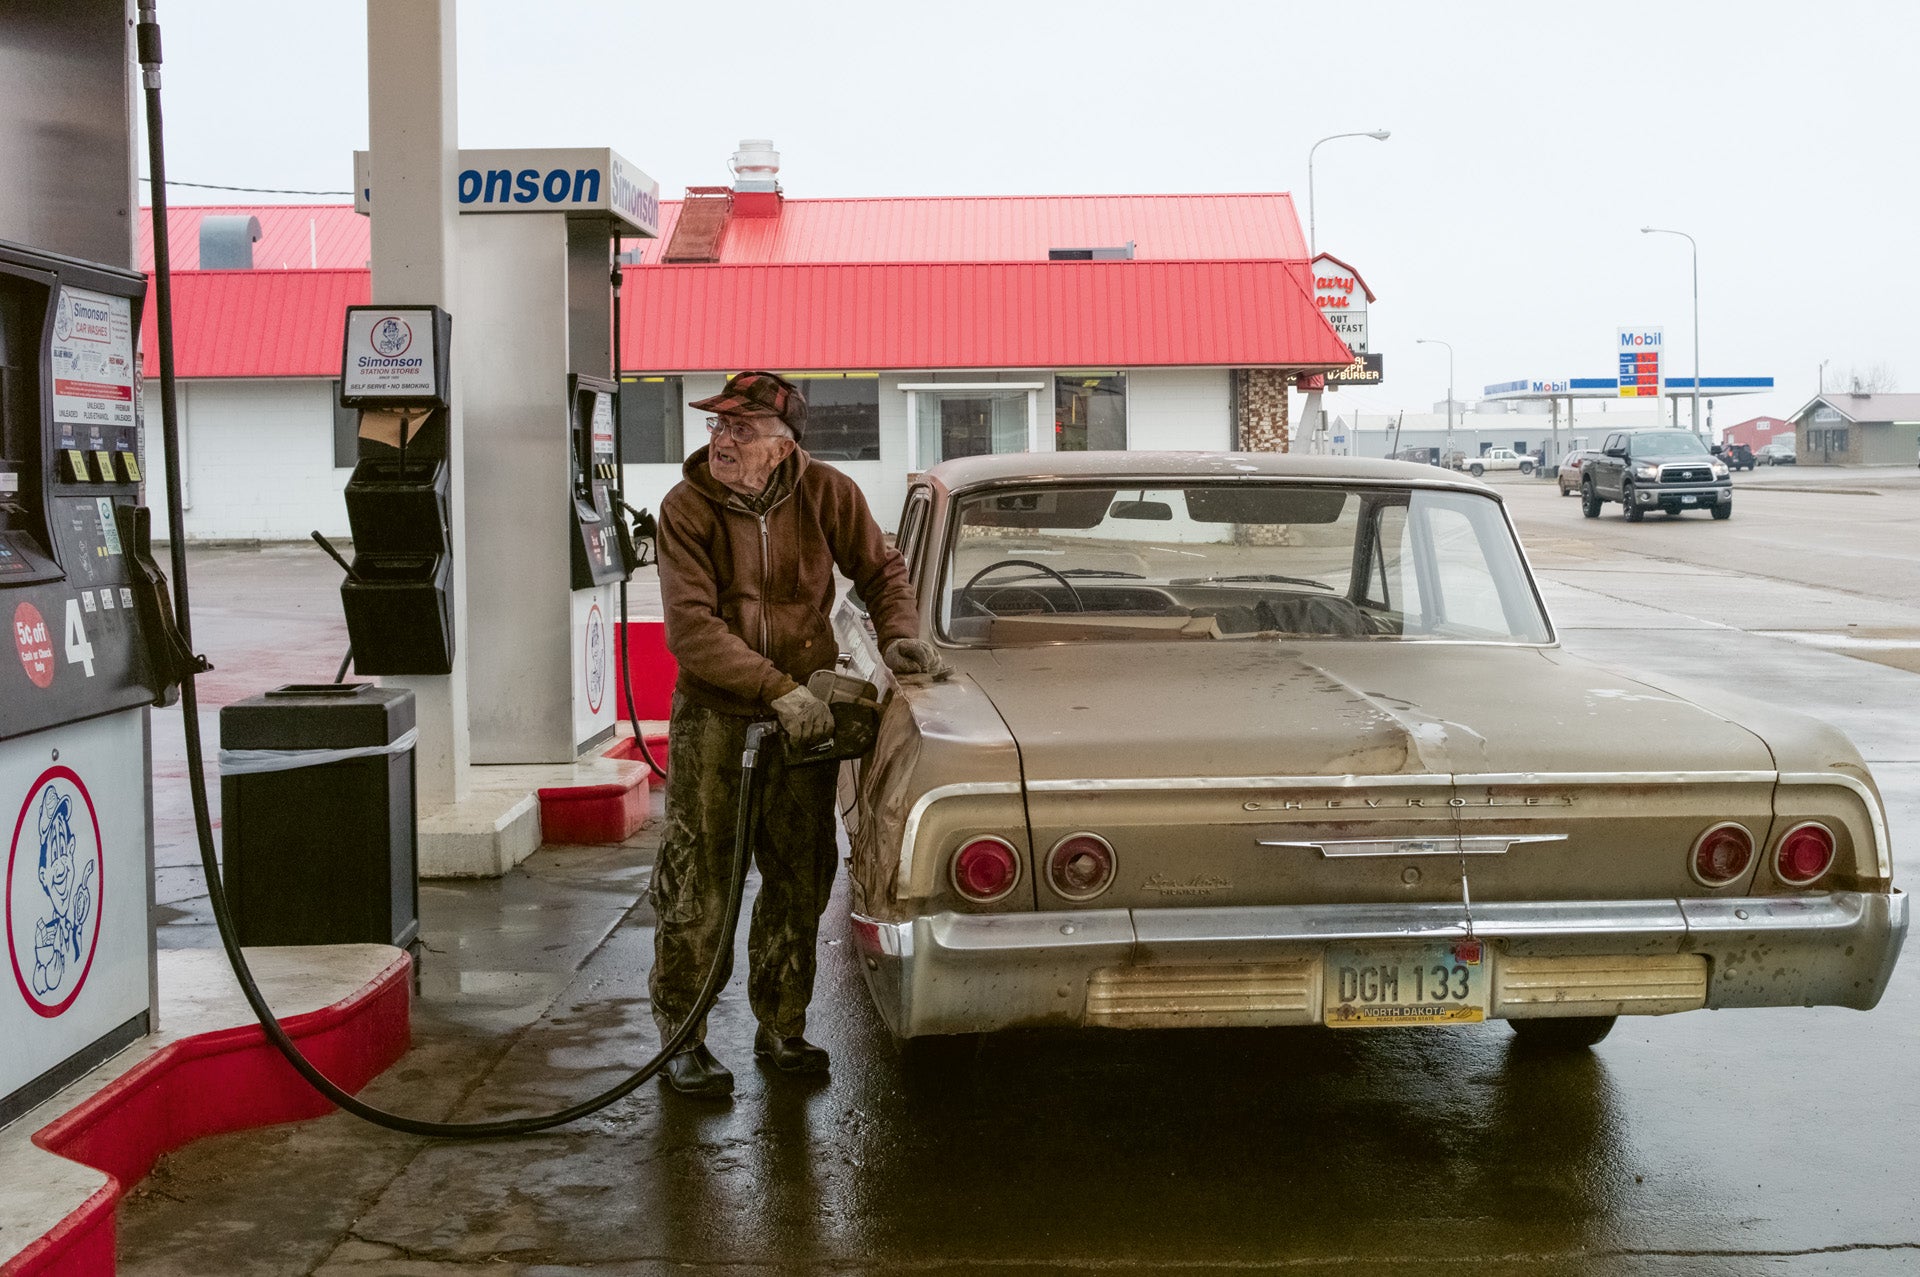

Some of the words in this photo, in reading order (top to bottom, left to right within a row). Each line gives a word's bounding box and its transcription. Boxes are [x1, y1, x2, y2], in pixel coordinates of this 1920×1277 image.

[612, 160, 659, 230] Simonson
[1311, 272, 1354, 294] airy
[1316, 295, 1350, 308] arn
[73, 302, 109, 322] Simonson
[1330, 315, 1348, 323] OUT
[76, 322, 87, 334] CAR
[88, 325, 108, 337] WASHES
[1332, 324, 1364, 333] KFAST
[1621, 332, 1662, 346] Mobil
[358, 356, 423, 368] Simonson
[1354, 356, 1368, 365] AL
[390, 367, 420, 375] STORES
[1532, 381, 1568, 393] Mobil
[600, 529, 612, 567] 2
[33, 622, 47, 643] off
[65, 598, 95, 678] 4
[1243, 796, 1579, 811] CHEVROLET
[1338, 965, 1399, 1002] DGM
[1413, 965, 1470, 1001] 133
[1364, 1007, 1400, 1017] NORTH
[1403, 1006, 1447, 1016] DAKOTA
